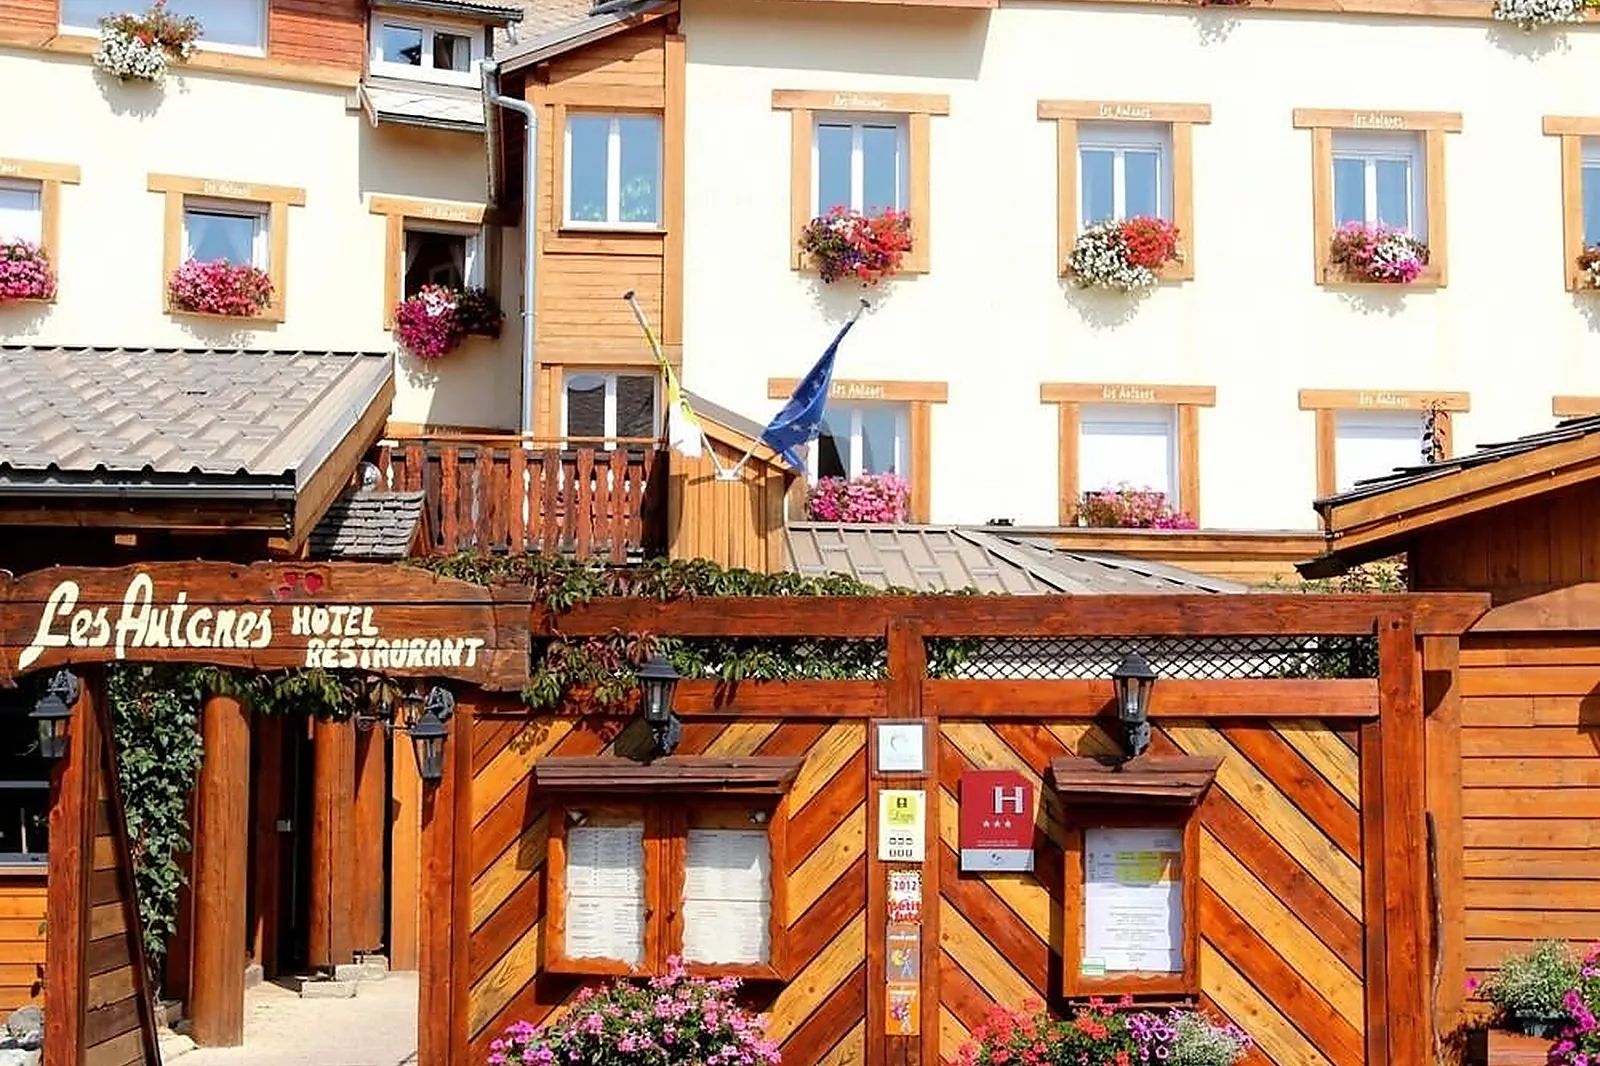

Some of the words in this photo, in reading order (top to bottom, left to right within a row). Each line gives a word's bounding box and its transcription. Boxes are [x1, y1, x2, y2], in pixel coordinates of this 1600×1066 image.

[18, 581, 111, 670] Les
[115, 573, 272, 659] Autanes
[305, 637, 485, 669] RESTAURANT
[995, 786, 1023, 813] H
[893, 880, 917, 891] 2012
